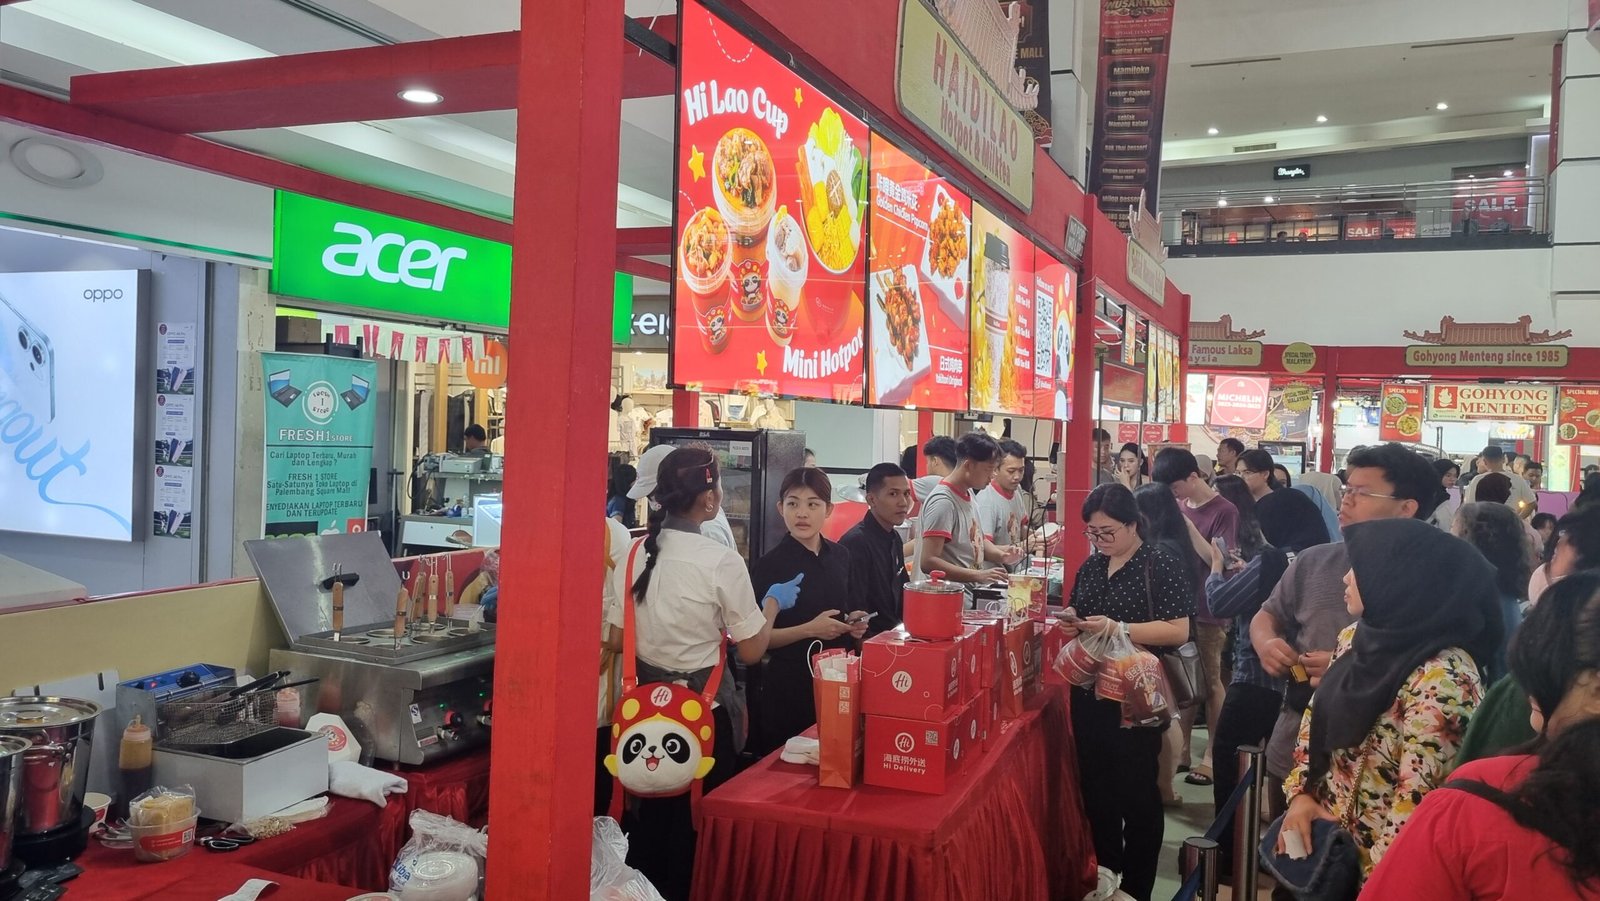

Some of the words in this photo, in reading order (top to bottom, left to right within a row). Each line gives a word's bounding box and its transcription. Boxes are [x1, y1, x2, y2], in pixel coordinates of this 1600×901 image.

[1020, 47, 1045, 59] MALL
[933, 31, 1018, 162] HAIDILAO
[683, 80, 706, 126] Hi
[710, 85, 749, 114] Lao
[752, 86, 789, 139] Cup
[940, 95, 974, 155] Hotpot
[1464, 196, 1516, 211] SALE
[1347, 226, 1379, 239] SALE
[321, 221, 468, 292] acer
[83, 288, 123, 303] oppo
[783, 345, 818, 380] Mini
[819, 327, 864, 379] Hotpot
[1191, 344, 1226, 355] Famous
[1228, 344, 1253, 355] Laksa
[1413, 350, 1457, 364] Gohyong
[1459, 350, 1504, 365] Menteng
[1506, 350, 1533, 362] since
[1536, 350, 1560, 362] 1985
[1217, 393, 1262, 402] MICHELIN
[1459, 388, 1548, 401] GOHYONG
[1459, 402, 1548, 415] MENTENG
[270, 451, 285, 459] Cari
[286, 451, 310, 460] Laptop
[337, 451, 357, 459] Murah
[291, 459, 305, 467] dan
[288, 473, 313, 481] FRESH
[267, 480, 314, 489] Satu-Satunya
[329, 480, 350, 488] Laptop
[351, 479, 357, 487] di
[275, 487, 315, 497] Palembang
[316, 488, 335, 497] Square
[336, 487, 350, 495] Mall
[311, 501, 334, 510] LAPTOP
[334, 500, 363, 509] TERBARU
[286, 509, 303, 517] DAN
[304, 508, 338, 517] TERUPDATE
[894, 675, 909, 689] Hi
[653, 688, 669, 704] Hi
[899, 736, 910, 748] Hi
[893, 763, 926, 775] Delivery
